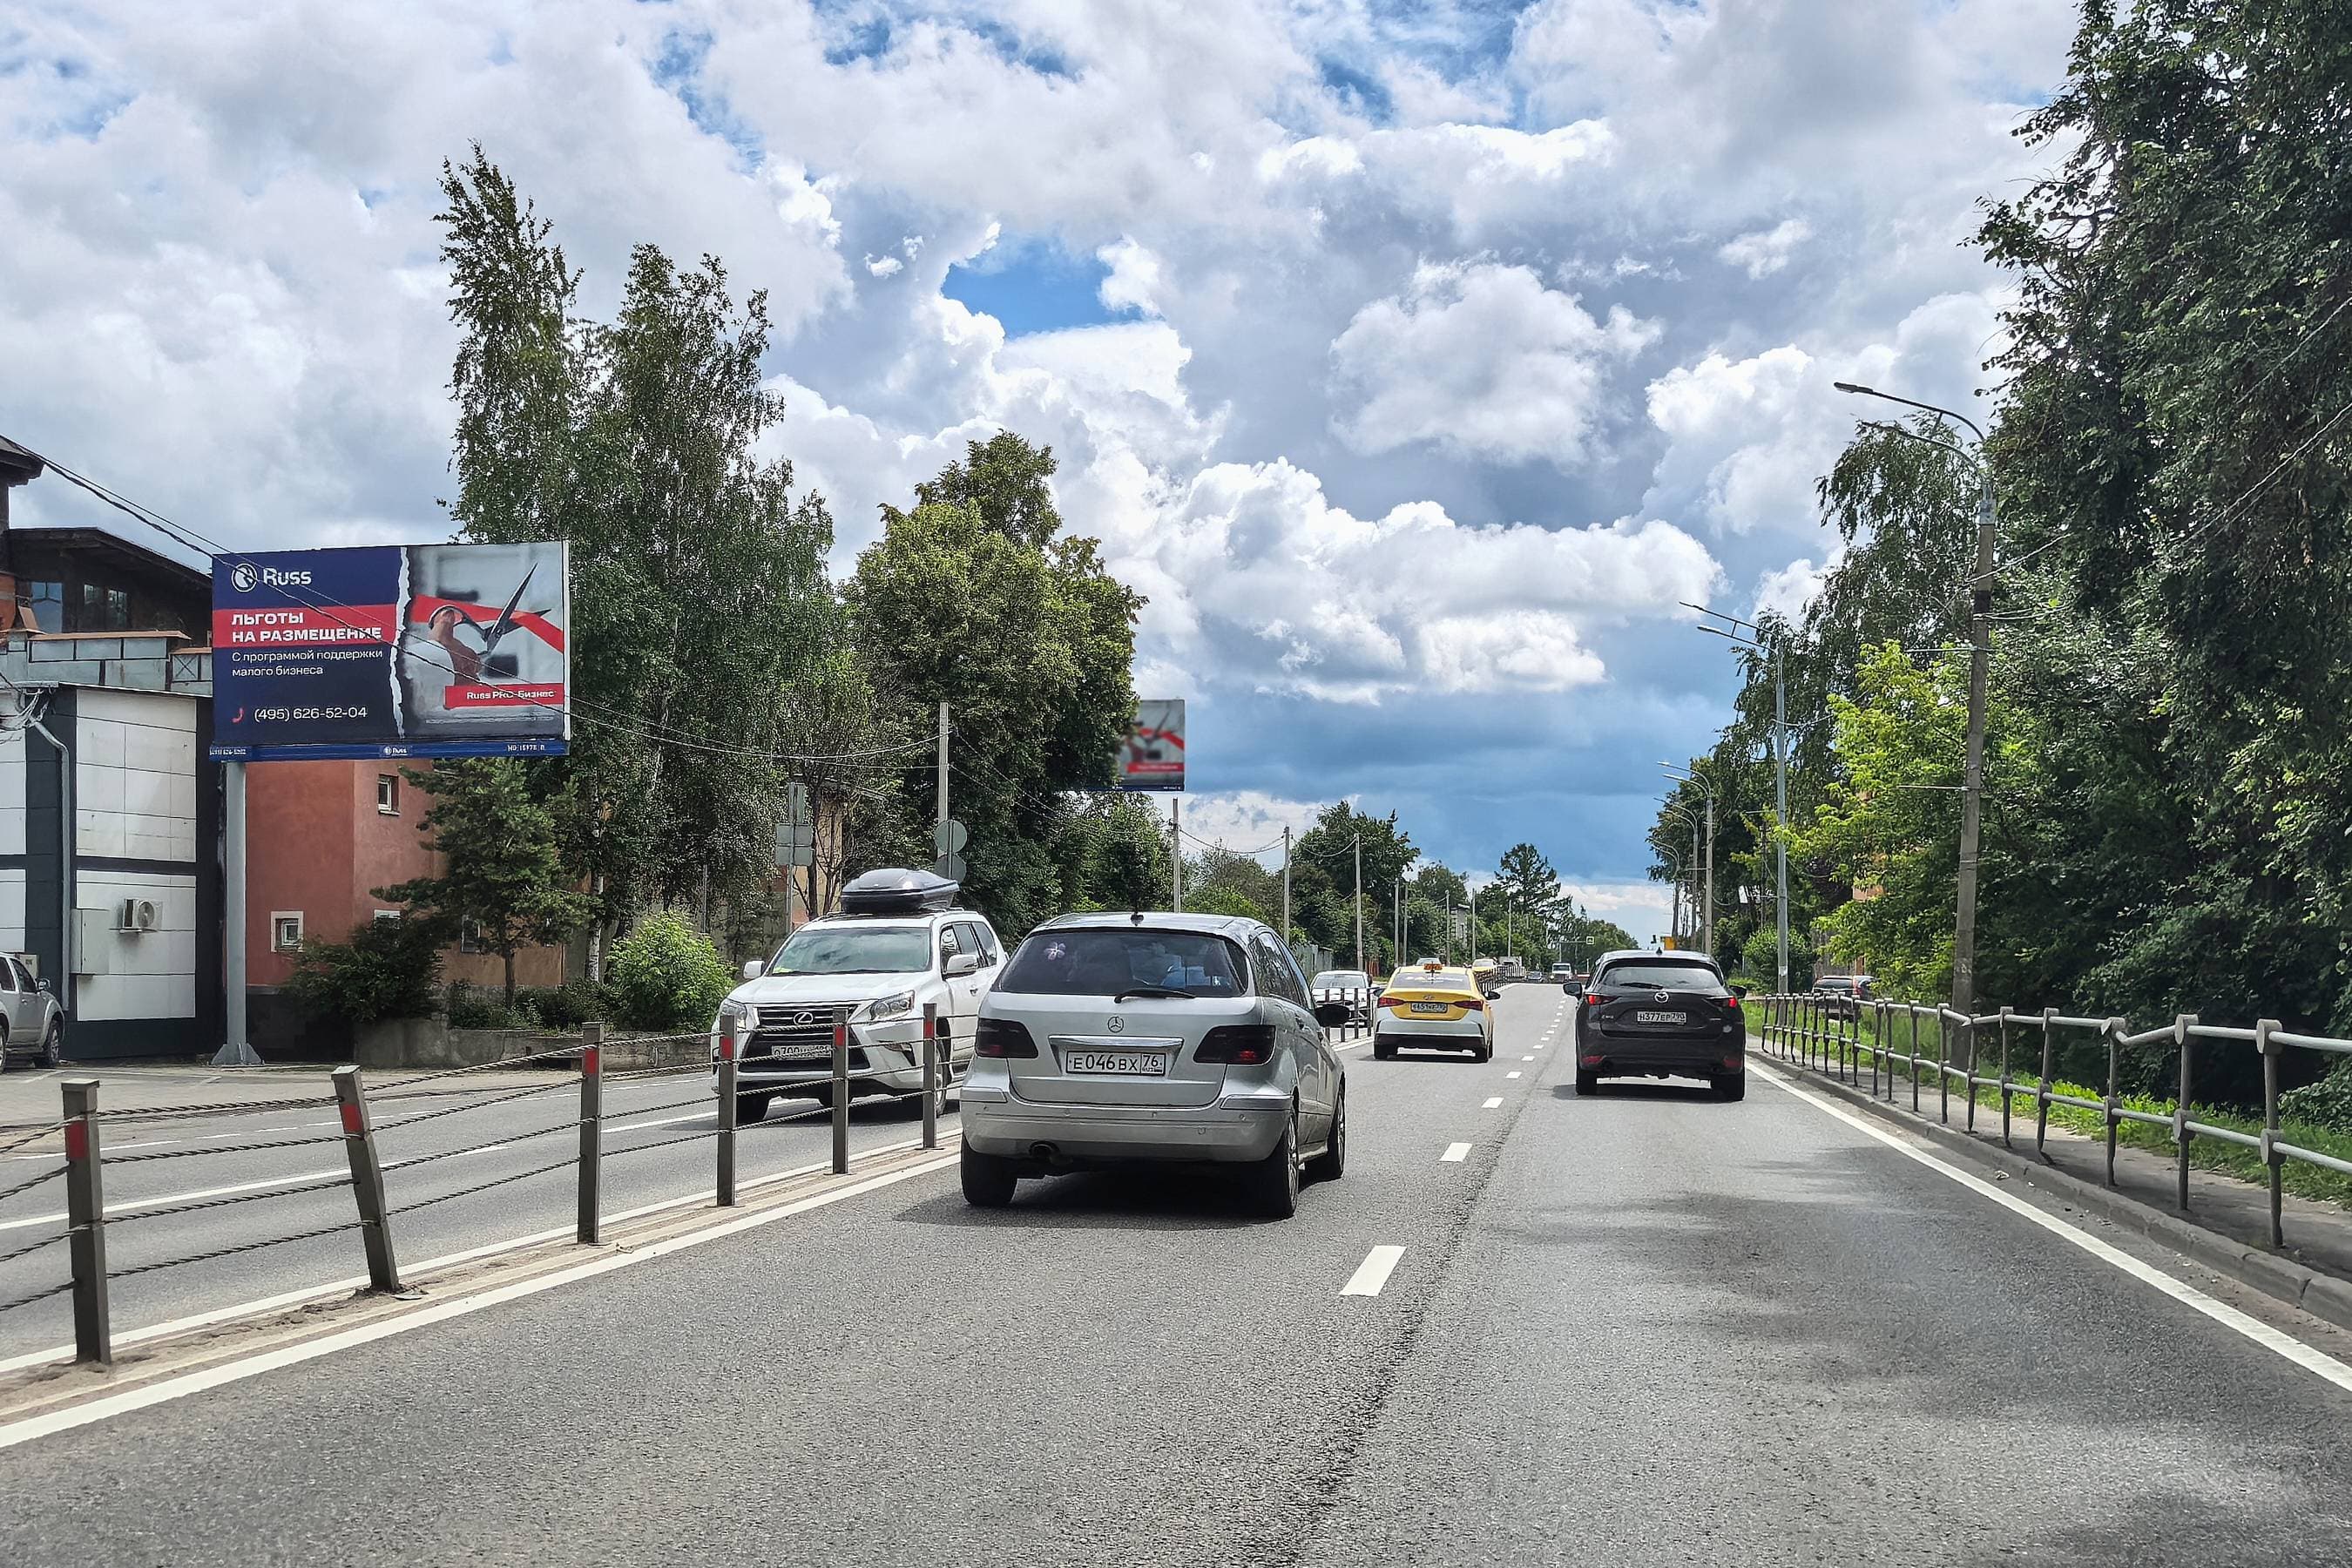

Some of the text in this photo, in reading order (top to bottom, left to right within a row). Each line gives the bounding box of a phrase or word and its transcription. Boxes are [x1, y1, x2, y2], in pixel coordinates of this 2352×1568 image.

[263, 567, 312, 586] Russ
[231, 612, 304, 625] ЛЬГОТЫ
[232, 627, 382, 643] НА РАЗМЕЩЕНИЕ
[232, 649, 383, 664] С программой поддержки
[232, 665, 324, 677] малого бизнеса
[466, 692, 491, 700] Russ
[254, 706, 368, 723] (495) 626-52-04
[1073, 1054, 1159, 1071] Е046ВХ 76
